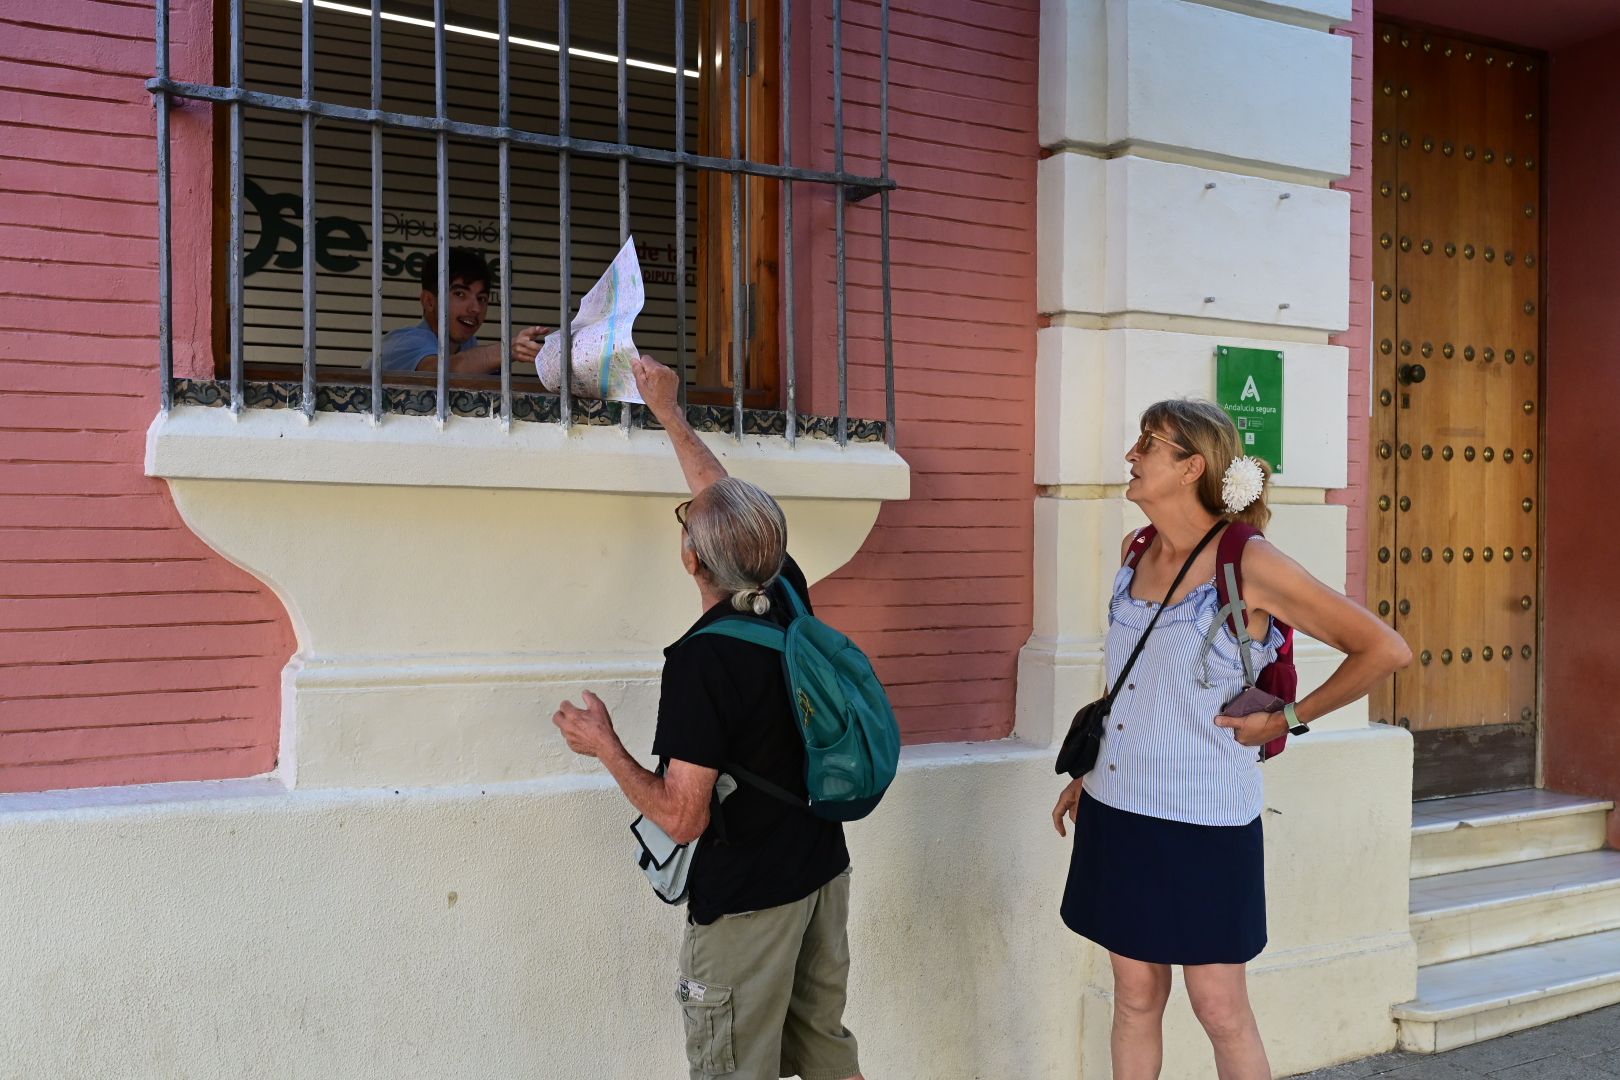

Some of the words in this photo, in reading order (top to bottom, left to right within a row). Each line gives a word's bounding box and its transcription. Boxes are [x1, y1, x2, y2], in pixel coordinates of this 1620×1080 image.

[382, 212, 507, 244] Dipuació
[643, 270, 697, 285] DIPUTCI
[1255, 405, 1277, 415] segura
